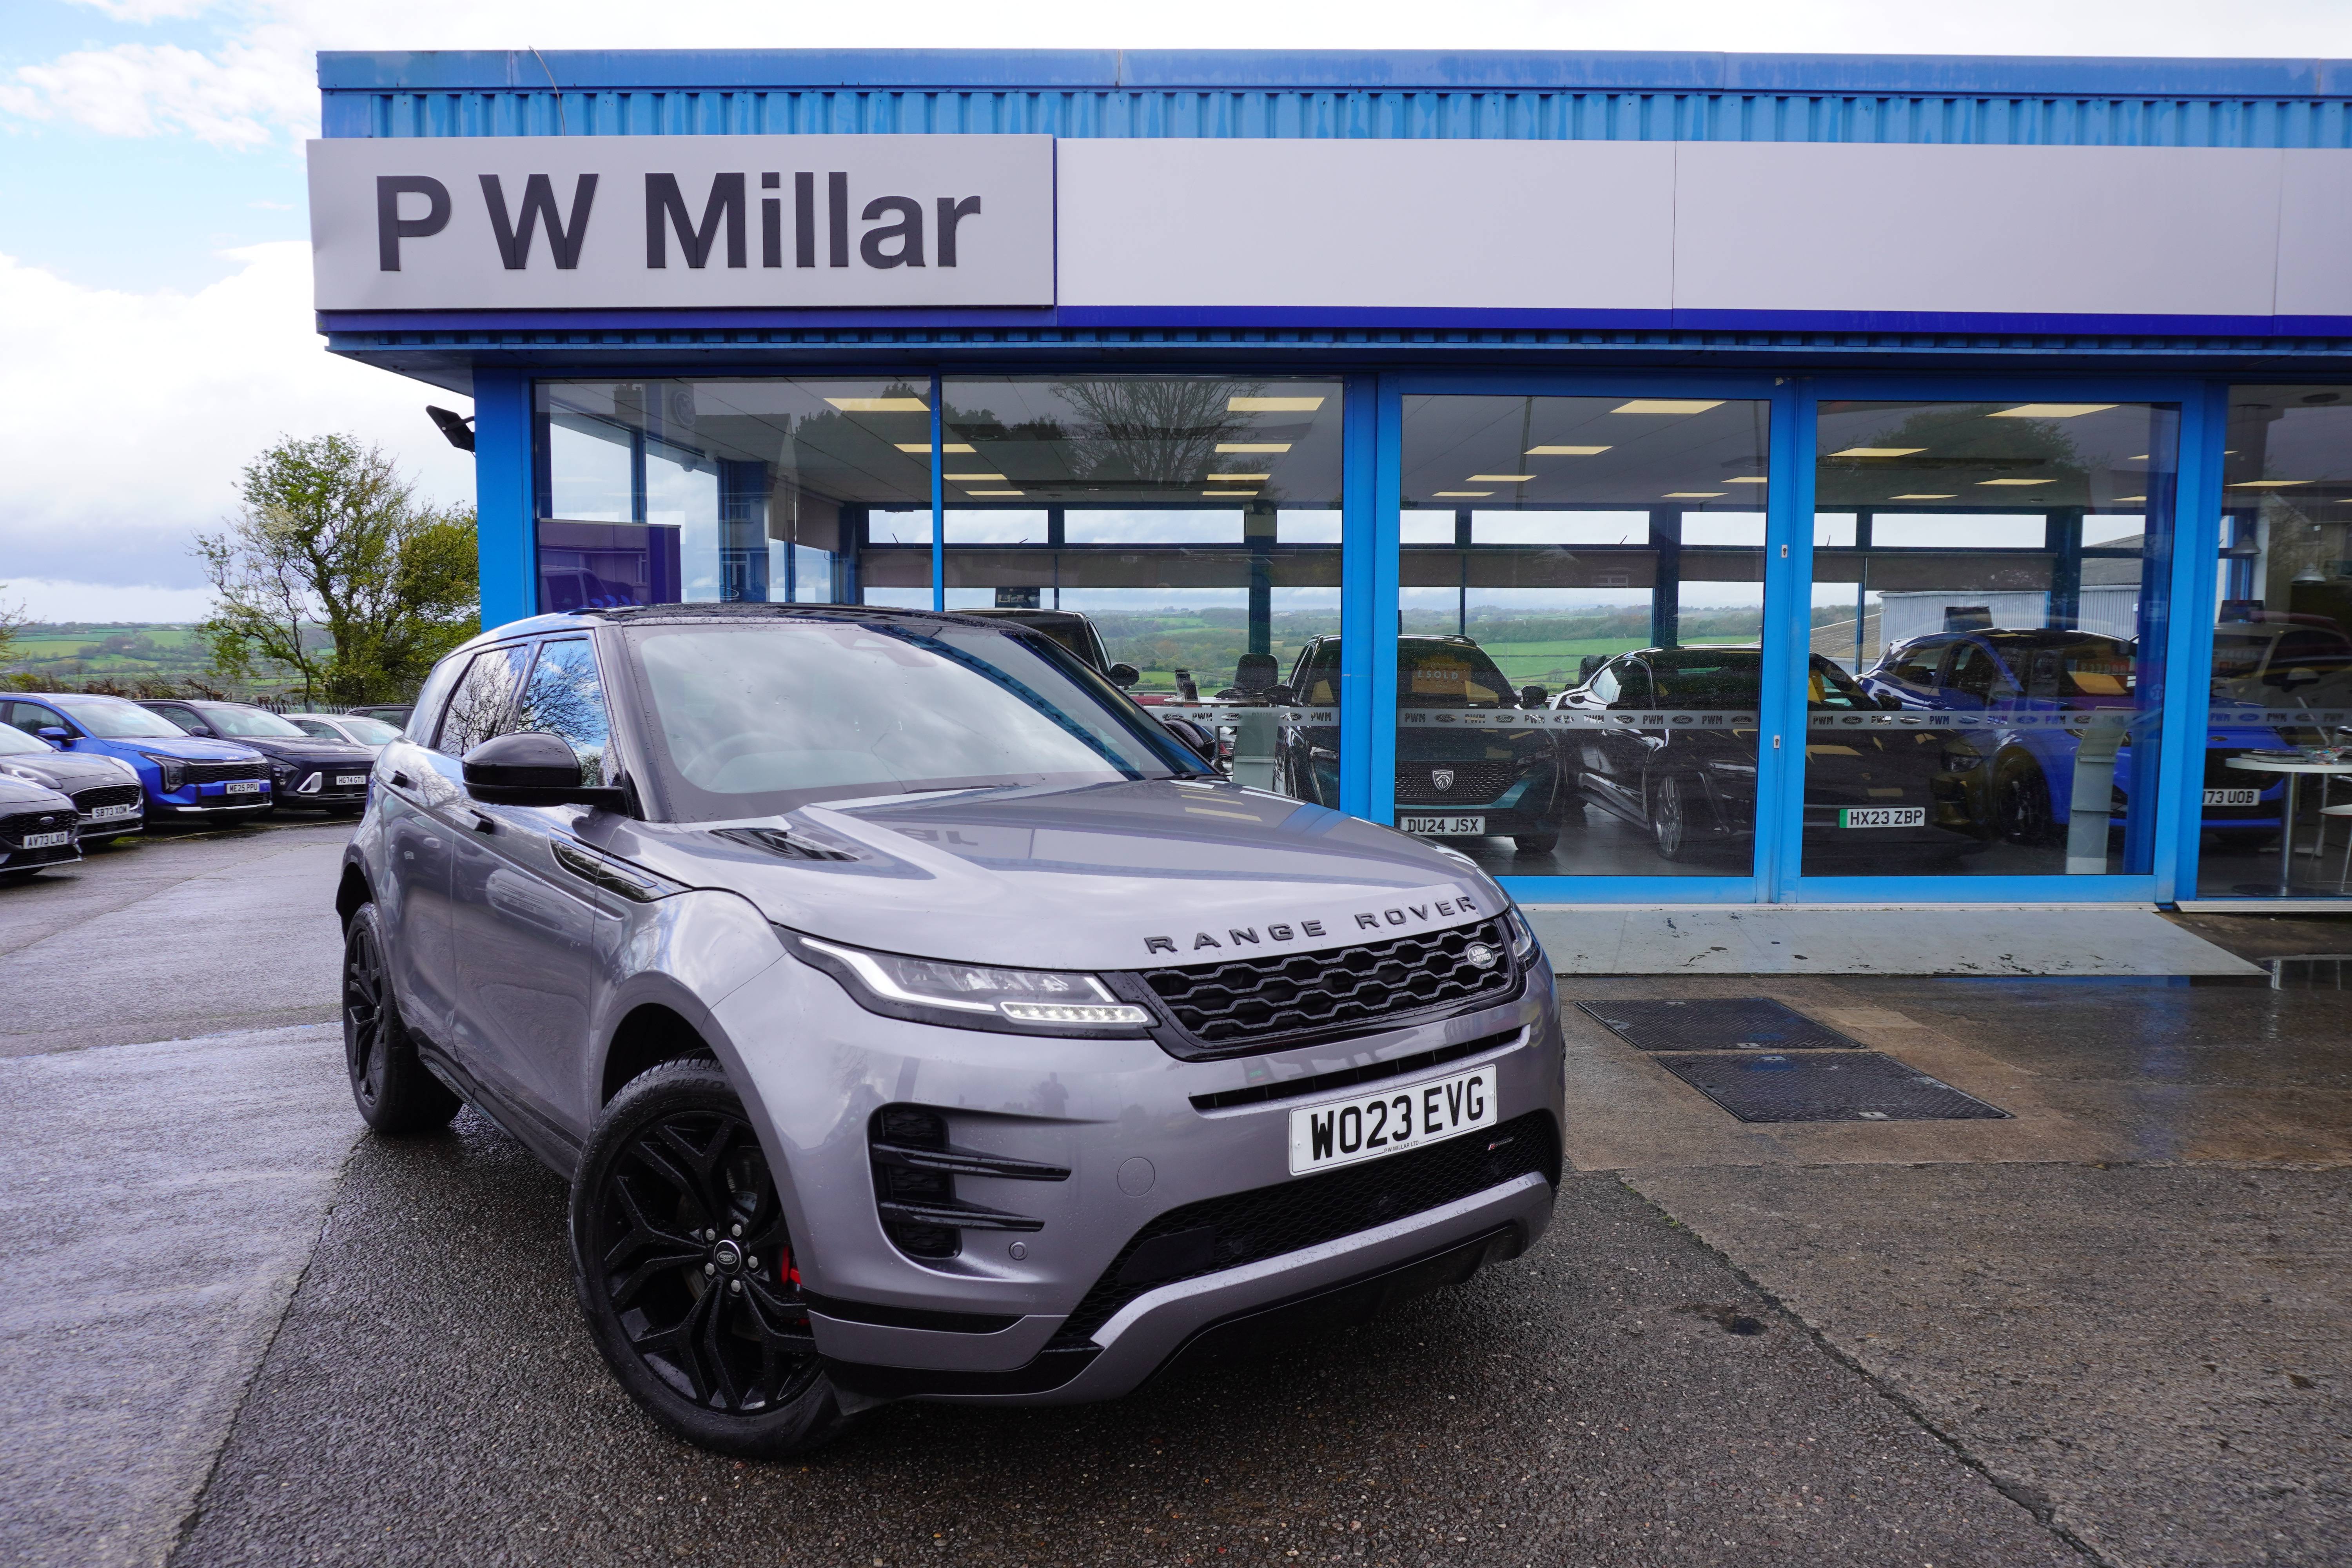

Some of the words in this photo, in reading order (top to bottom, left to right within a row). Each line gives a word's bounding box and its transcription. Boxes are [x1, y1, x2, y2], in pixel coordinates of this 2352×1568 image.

[376, 175, 452, 271] P
[478, 173, 600, 270] W
[645, 171, 981, 269] Millar
[1192, 713, 1212, 721] PWM
[1311, 712, 1331, 721] PWM
[1405, 713, 1426, 722] PWM
[1465, 714, 1485, 723] PWM
[1524, 715, 1545, 724] PWM
[1584, 715, 1604, 724] PWM
[1643, 715, 1663, 724] PWM
[1702, 715, 1722, 724] PWM
[1813, 716, 1833, 725] PWM
[1871, 716, 1891, 725] PWM
[1929, 716, 1949, 725] PWM
[2228, 791, 2254, 803] UOB
[96, 808, 113, 817] SB73
[115, 806, 127, 815] XOM
[1850, 811, 1889, 825] HX23
[1894, 810, 1923, 824] ZBP
[1407, 819, 1446, 832] DU24
[1451, 819, 1478, 832] JSX
[27, 835, 49, 847] AV73
[51, 834, 64, 844] LXO
[1144, 919, 1326, 954] RANGE
[1354, 896, 1476, 929] ROVER
[1471, 948, 1486, 956] LAND
[1476, 953, 1492, 962] ROVER
[1311, 1094, 1412, 1161] WO23
[1424, 1076, 1484, 1134] EVG
